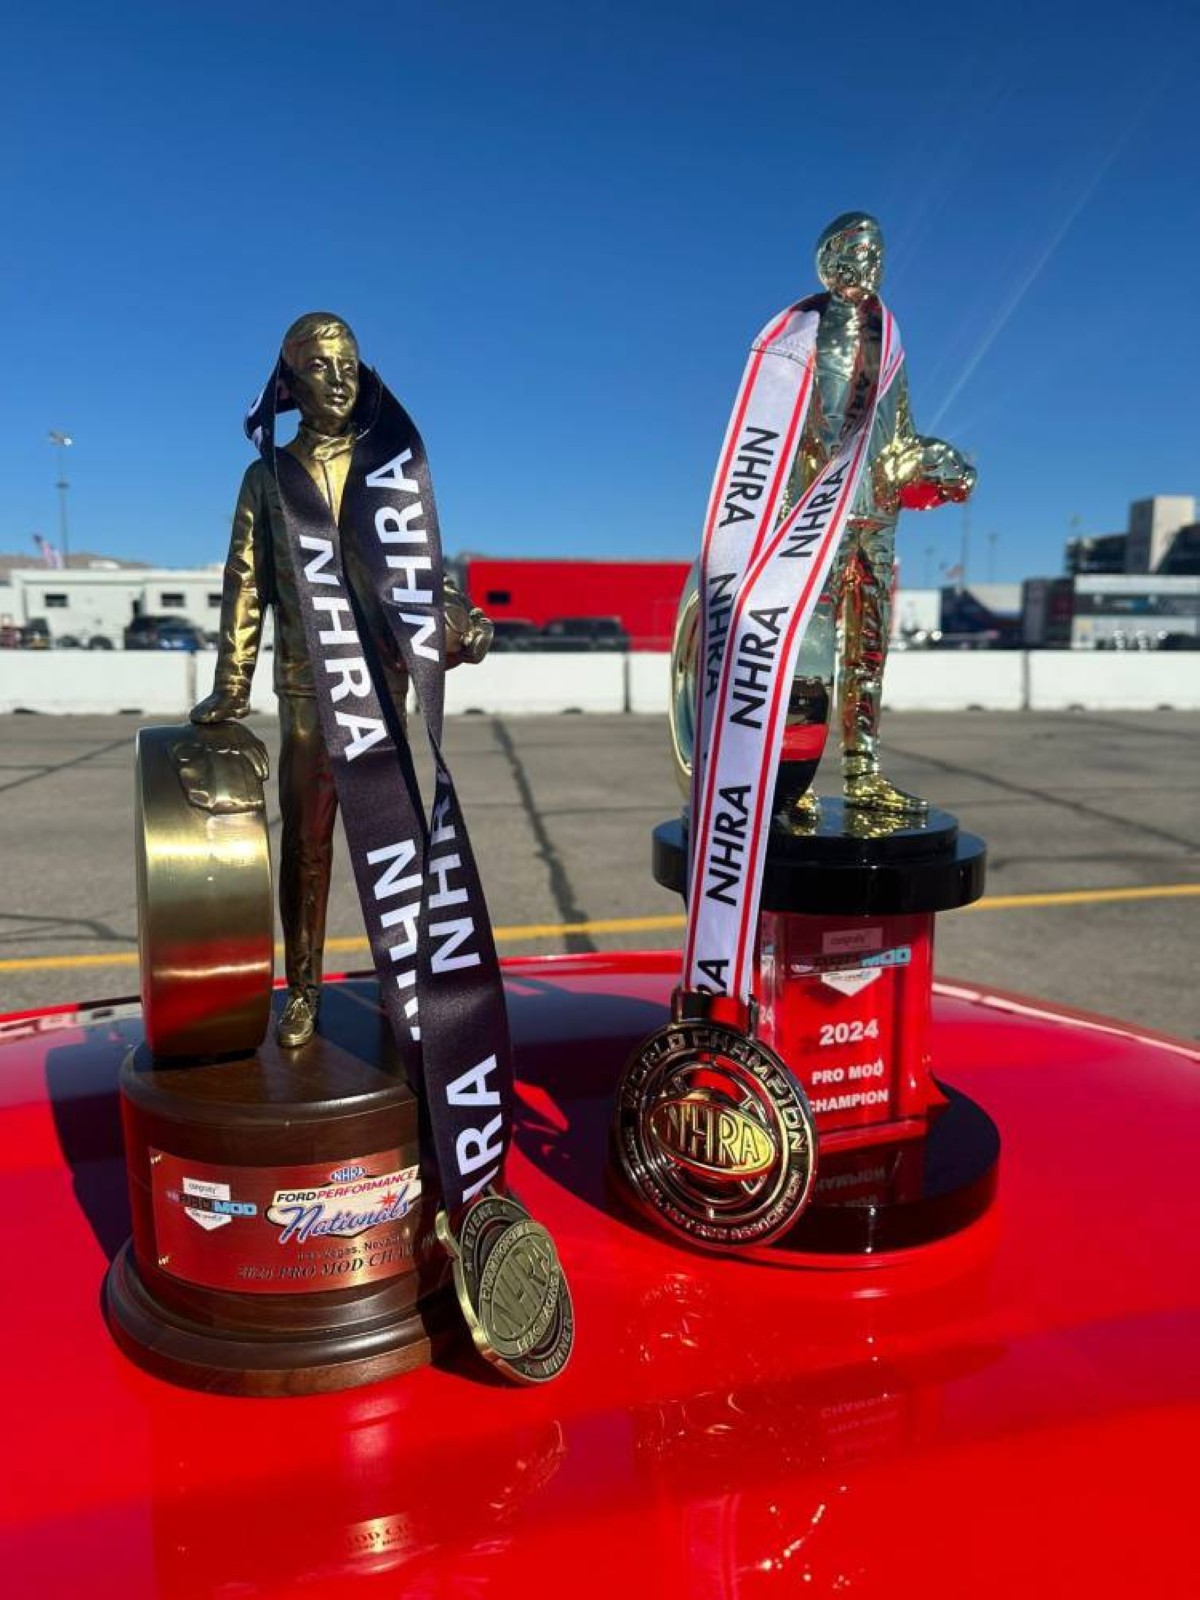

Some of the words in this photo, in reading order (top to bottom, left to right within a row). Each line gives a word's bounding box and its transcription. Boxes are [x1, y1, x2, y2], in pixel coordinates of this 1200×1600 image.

[719, 427, 780, 528] NHRA
[779, 460, 850, 559] NHRA
[366, 447, 441, 662] NHRA
[300, 536, 388, 762] NHRA
[706, 572, 737, 699] NHRA
[730, 606, 789, 729] NHRA
[705, 785, 752, 907] NHRA
[811, 1068, 844, 1085] PRO
[848, 1057, 884, 1079] MOD
[819, 1018, 879, 1046] 2024
[663, 1102, 761, 1168] NHRA
[691, 1030, 809, 1153] CHAMPION
[278, 1182, 409, 1244] Nationals
[331, 1166, 367, 1183] NHRA
[321, 1257, 364, 1276] MOD
[463, 1203, 493, 1249] EVENT
